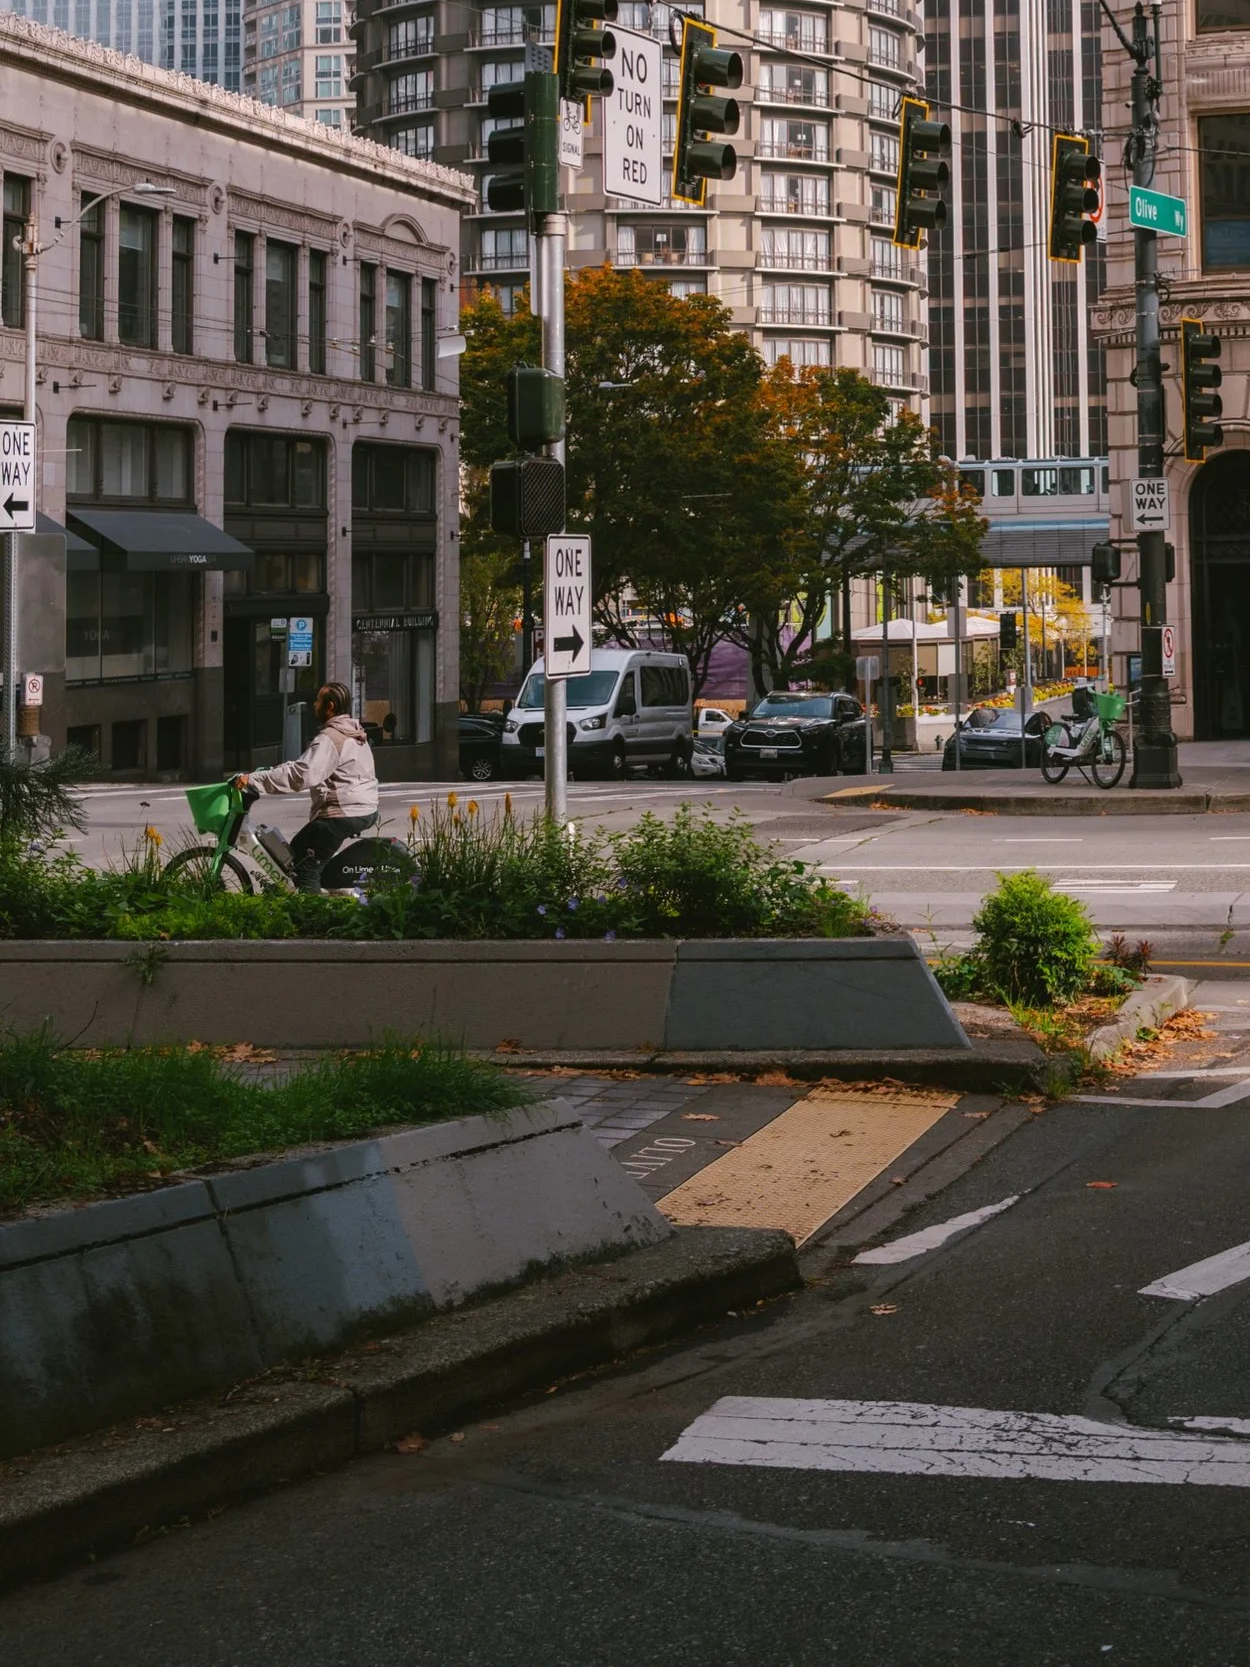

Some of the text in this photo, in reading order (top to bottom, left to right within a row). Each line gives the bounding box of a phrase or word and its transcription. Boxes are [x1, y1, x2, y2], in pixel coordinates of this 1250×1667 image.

[622, 47, 648, 84] NO
[617, 87, 651, 119] TURN
[562, 140, 581, 157] SIGNAL
[626, 124, 644, 151] ON
[622, 157, 648, 185] RED
[1135, 196, 1184, 232] Olive Wy
[2, 430, 30, 456] ONE
[1, 461, 31, 486] WAY
[1135, 482, 1165, 496] ONE
[1135, 497, 1166, 510] WAY
[555, 548, 582, 578] ONE
[554, 585, 584, 616] WAY
[356, 617, 400, 630] CENTENNIAL
[342, 866, 354, 874] On
[355, 865, 374, 874] Lime
